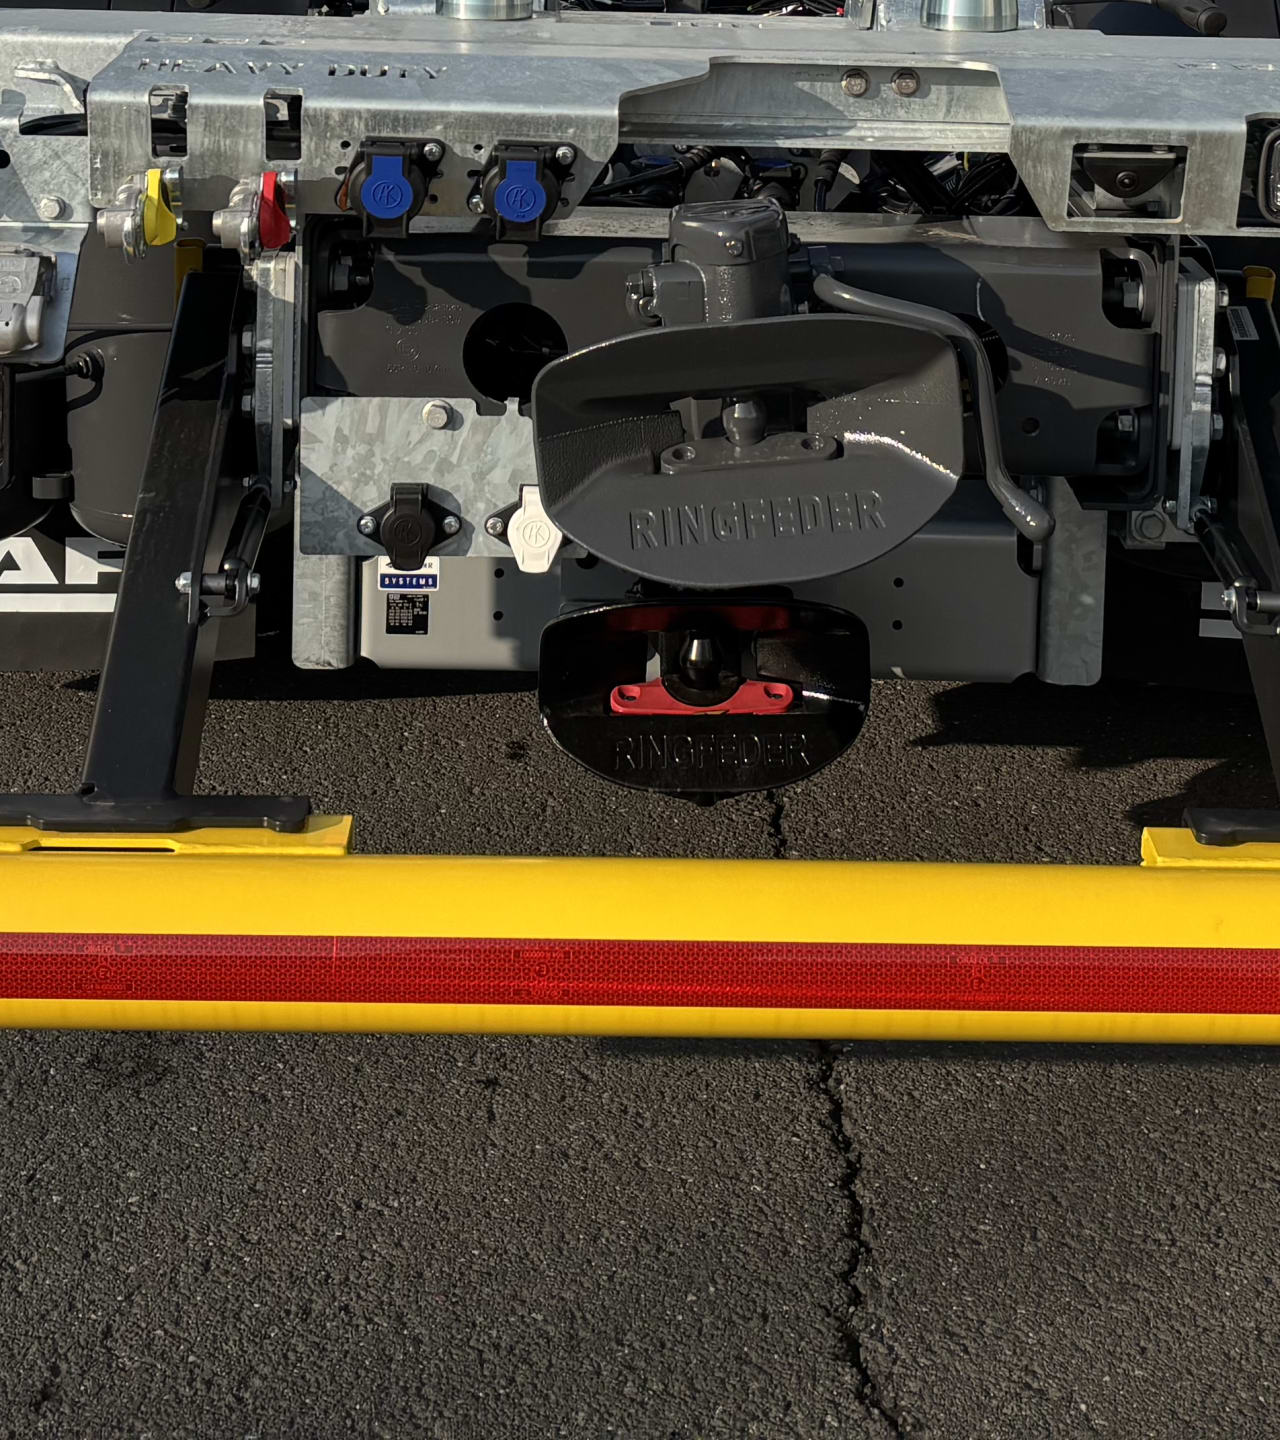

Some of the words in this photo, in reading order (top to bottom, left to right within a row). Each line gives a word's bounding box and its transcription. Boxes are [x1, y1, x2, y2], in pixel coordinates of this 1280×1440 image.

[137, 58, 305, 75] HEAVY
[327, 63, 448, 79] DUTY
[628, 490, 887, 551] RINGFEDER
[384, 577, 433, 586] SYSTEMS
[614, 733, 810, 770] RINGFEDER
